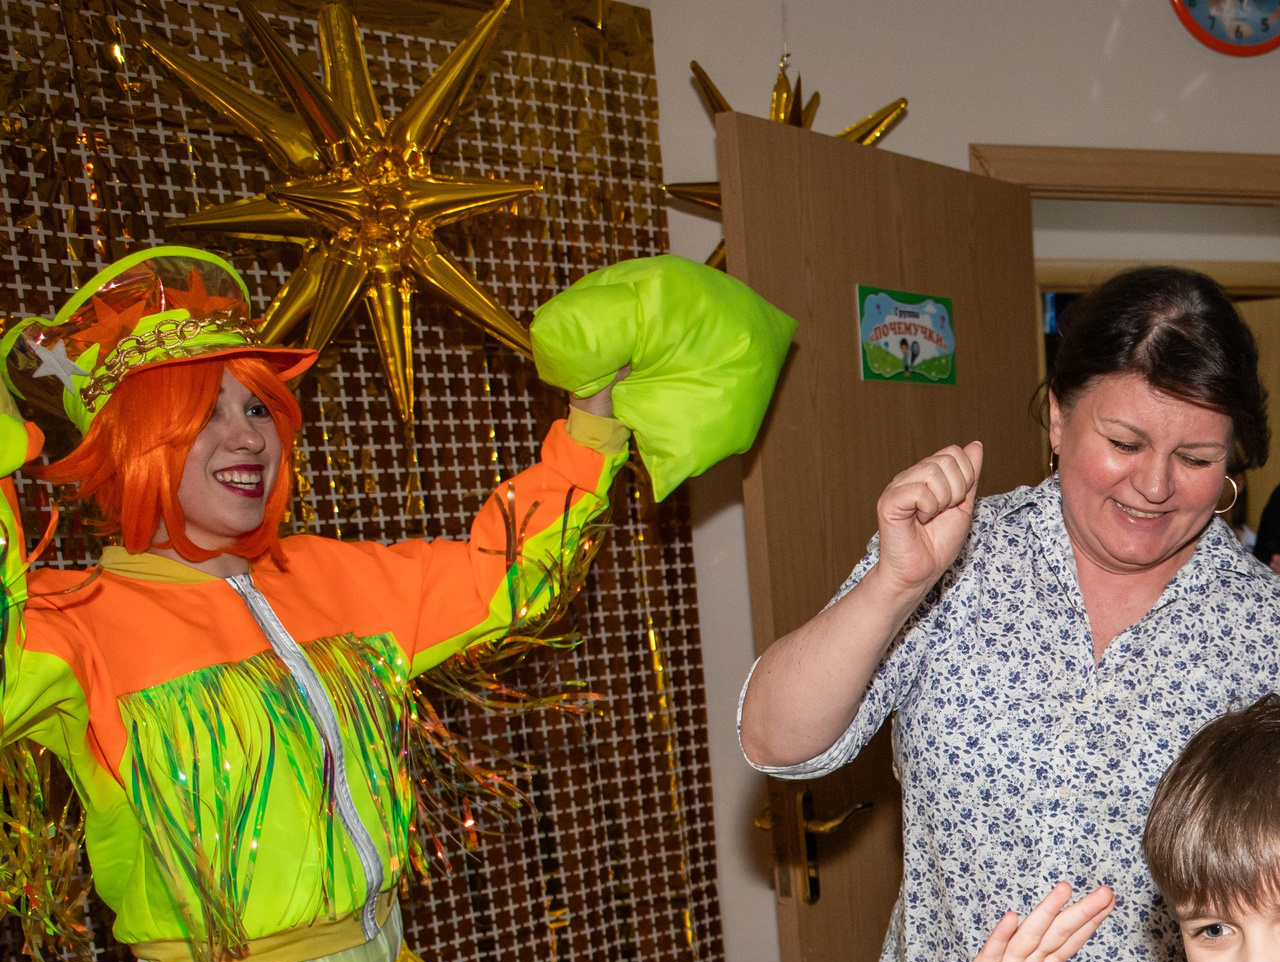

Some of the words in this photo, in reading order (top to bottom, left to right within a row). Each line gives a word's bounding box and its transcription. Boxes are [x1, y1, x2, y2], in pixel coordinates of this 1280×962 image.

[1208, 15, 1216, 30] 7
[1261, 17, 1270, 32] 5
[1235, 25, 1243, 40] 6
